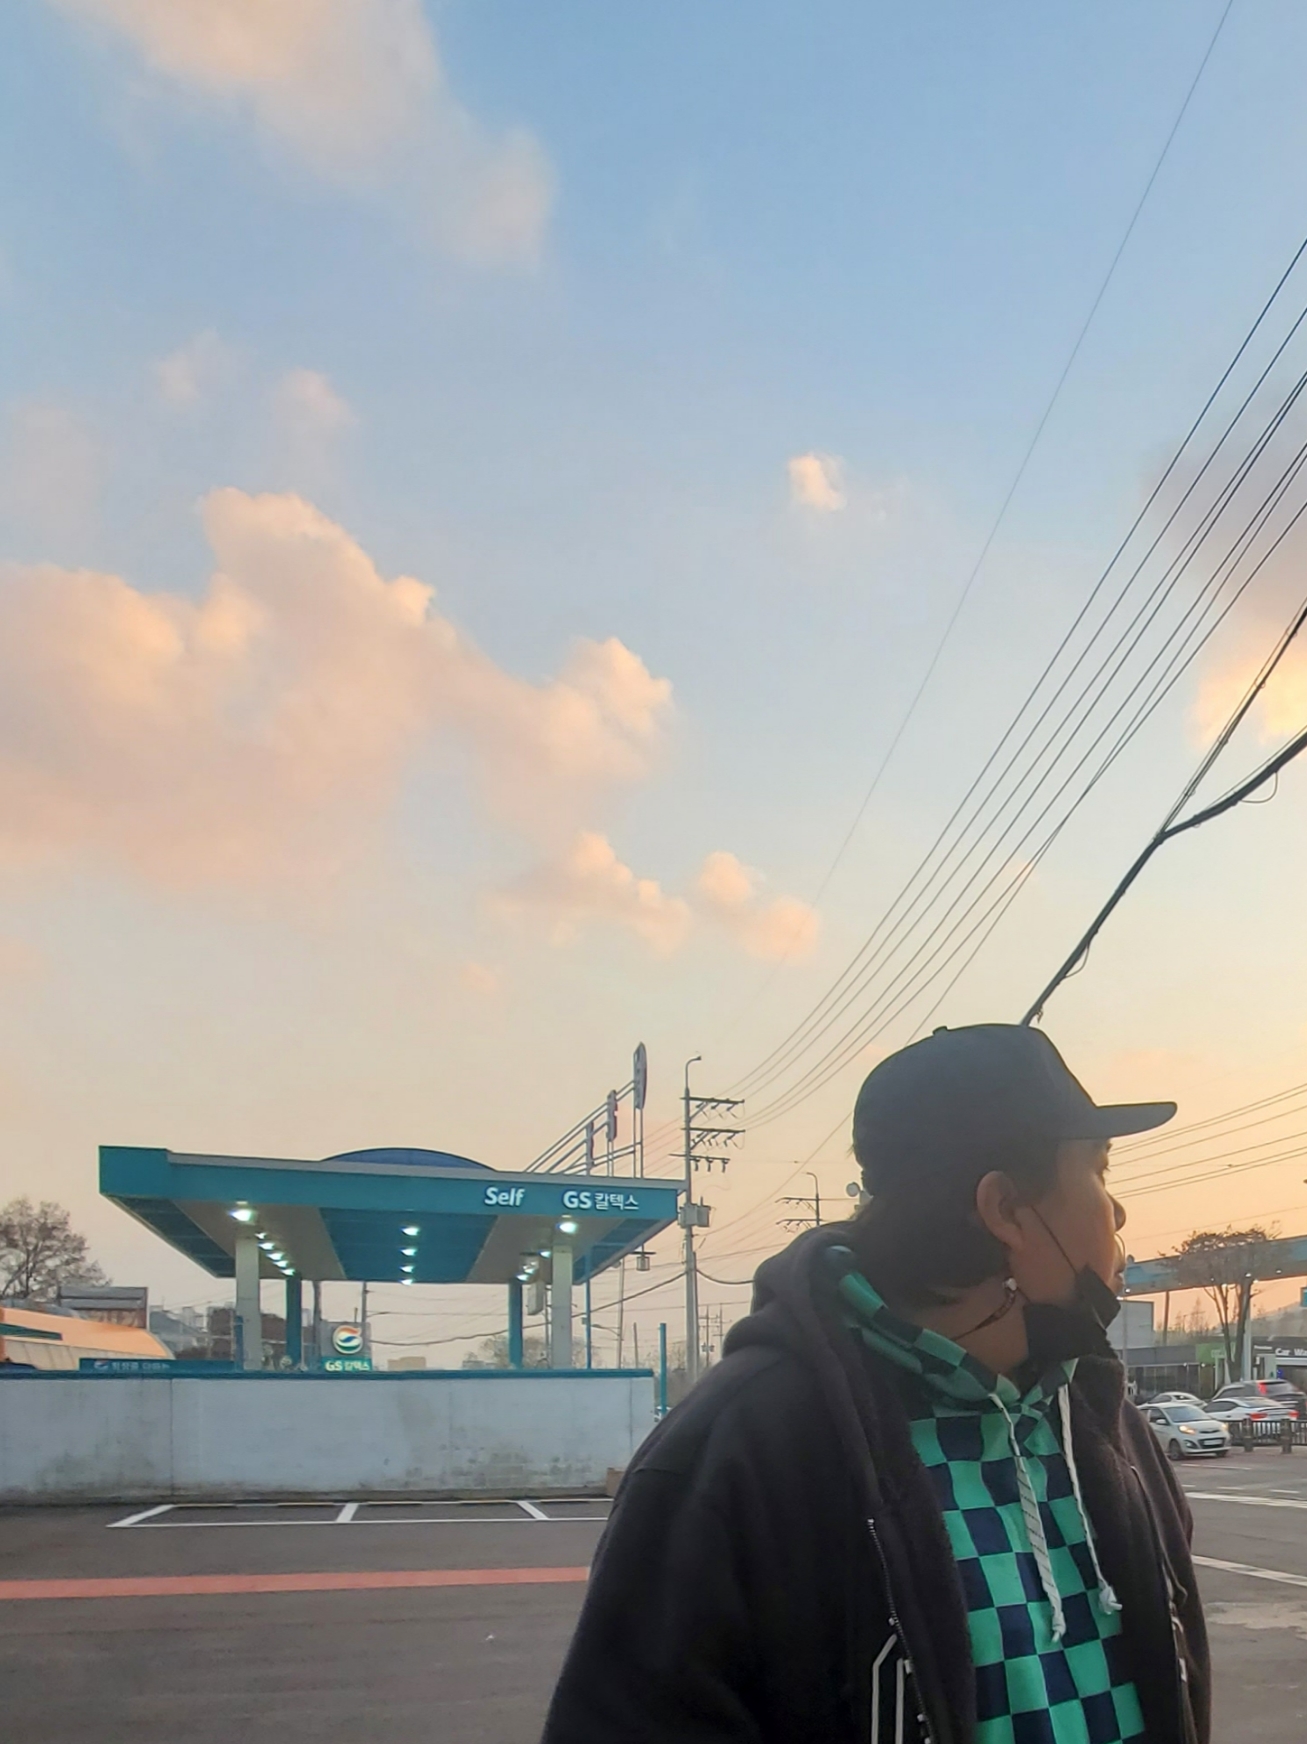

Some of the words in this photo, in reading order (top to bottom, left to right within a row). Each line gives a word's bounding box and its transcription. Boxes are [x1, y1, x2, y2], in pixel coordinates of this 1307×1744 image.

[484, 1186, 526, 1207] Self
[563, 1190, 592, 1210] GS
[594, 1192, 640, 1211] 칼텍스
[1274, 1347, 1291, 1357] Car
[325, 1360, 343, 1372] GS
